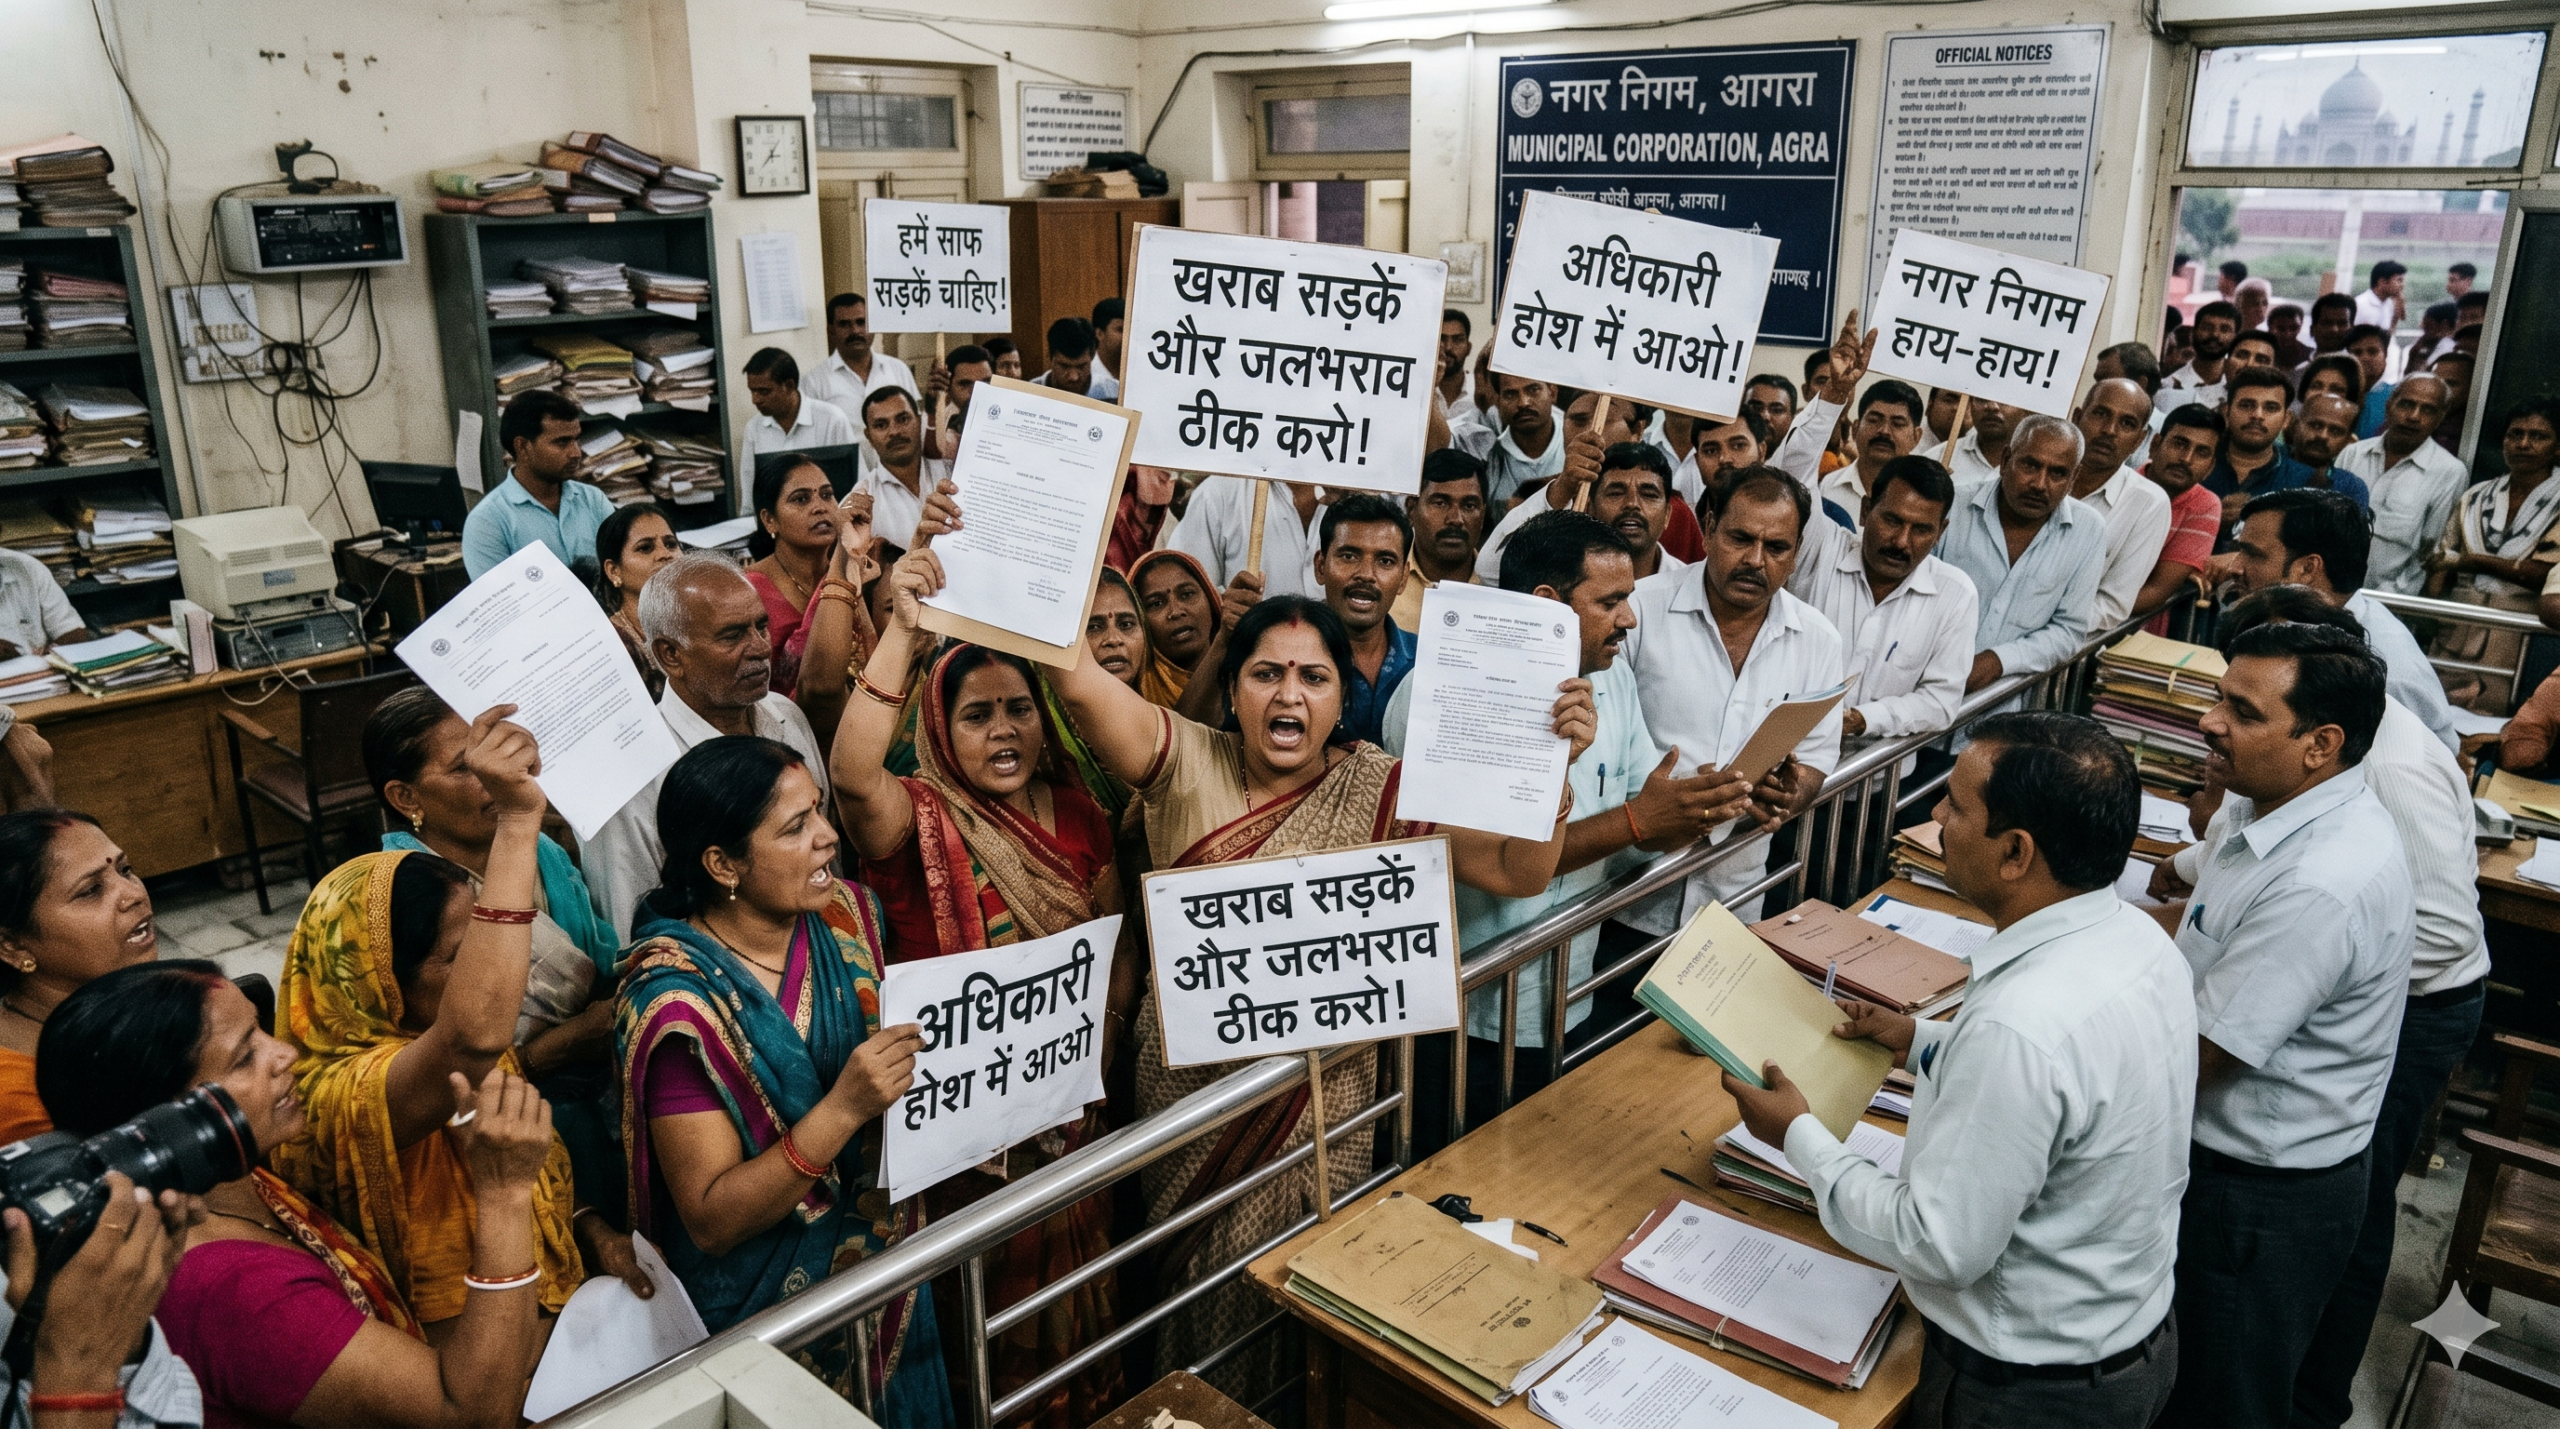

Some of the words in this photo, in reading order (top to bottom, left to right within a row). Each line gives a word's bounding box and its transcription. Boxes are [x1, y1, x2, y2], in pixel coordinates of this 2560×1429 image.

[1935, 47, 1992, 63] OFFICIAL
[1995, 44, 2053, 62] NOTICES
[1550, 79, 1611, 113] नगर
[1620, 65, 1706, 115] निगम,
[1721, 72, 1818, 108] आगरा
[1508, 134, 1608, 163] MUNICIPAL
[1613, 132, 1762, 169] CORPORATION,
[1768, 131, 1829, 162] AGRA
[1508, 191, 1519, 206] 1.
[897, 213, 929, 258] हमें
[936, 226, 983, 257] साफ
[873, 266, 931, 315] सड़कें
[939, 269, 1006, 315] चाहिए!
[1173, 258, 1285, 312] खराब
[1298, 261, 1407, 331] सड़कें
[1563, 235, 1722, 309] अधिकारी
[1902, 259, 1980, 309] नगर
[1987, 267, 2087, 334] निगम
[1147, 314, 1227, 379] और
[1239, 338, 1417, 399] जलभराव
[1511, 290, 1584, 353] होश
[1595, 304, 1625, 361] में
[1633, 323, 1744, 384] आओ!
[1891, 317, 2060, 389] हाय-हाय!
[1178, 388, 1263, 453] ठीक
[1275, 402, 1371, 466] करो!
[1181, 882, 1294, 930] खराब
[1306, 853, 1416, 918] सड़कें
[1173, 937, 1251, 991] और
[1262, 921, 1440, 977] जलभराव
[917, 938, 1096, 1053] अधिकारी
[1213, 992, 1299, 1045] ठीक
[1310, 974, 1407, 1031] करो!
[904, 1067, 977, 1132] होश
[985, 1043, 1013, 1097] में
[1022, 1011, 1095, 1083] आओ
